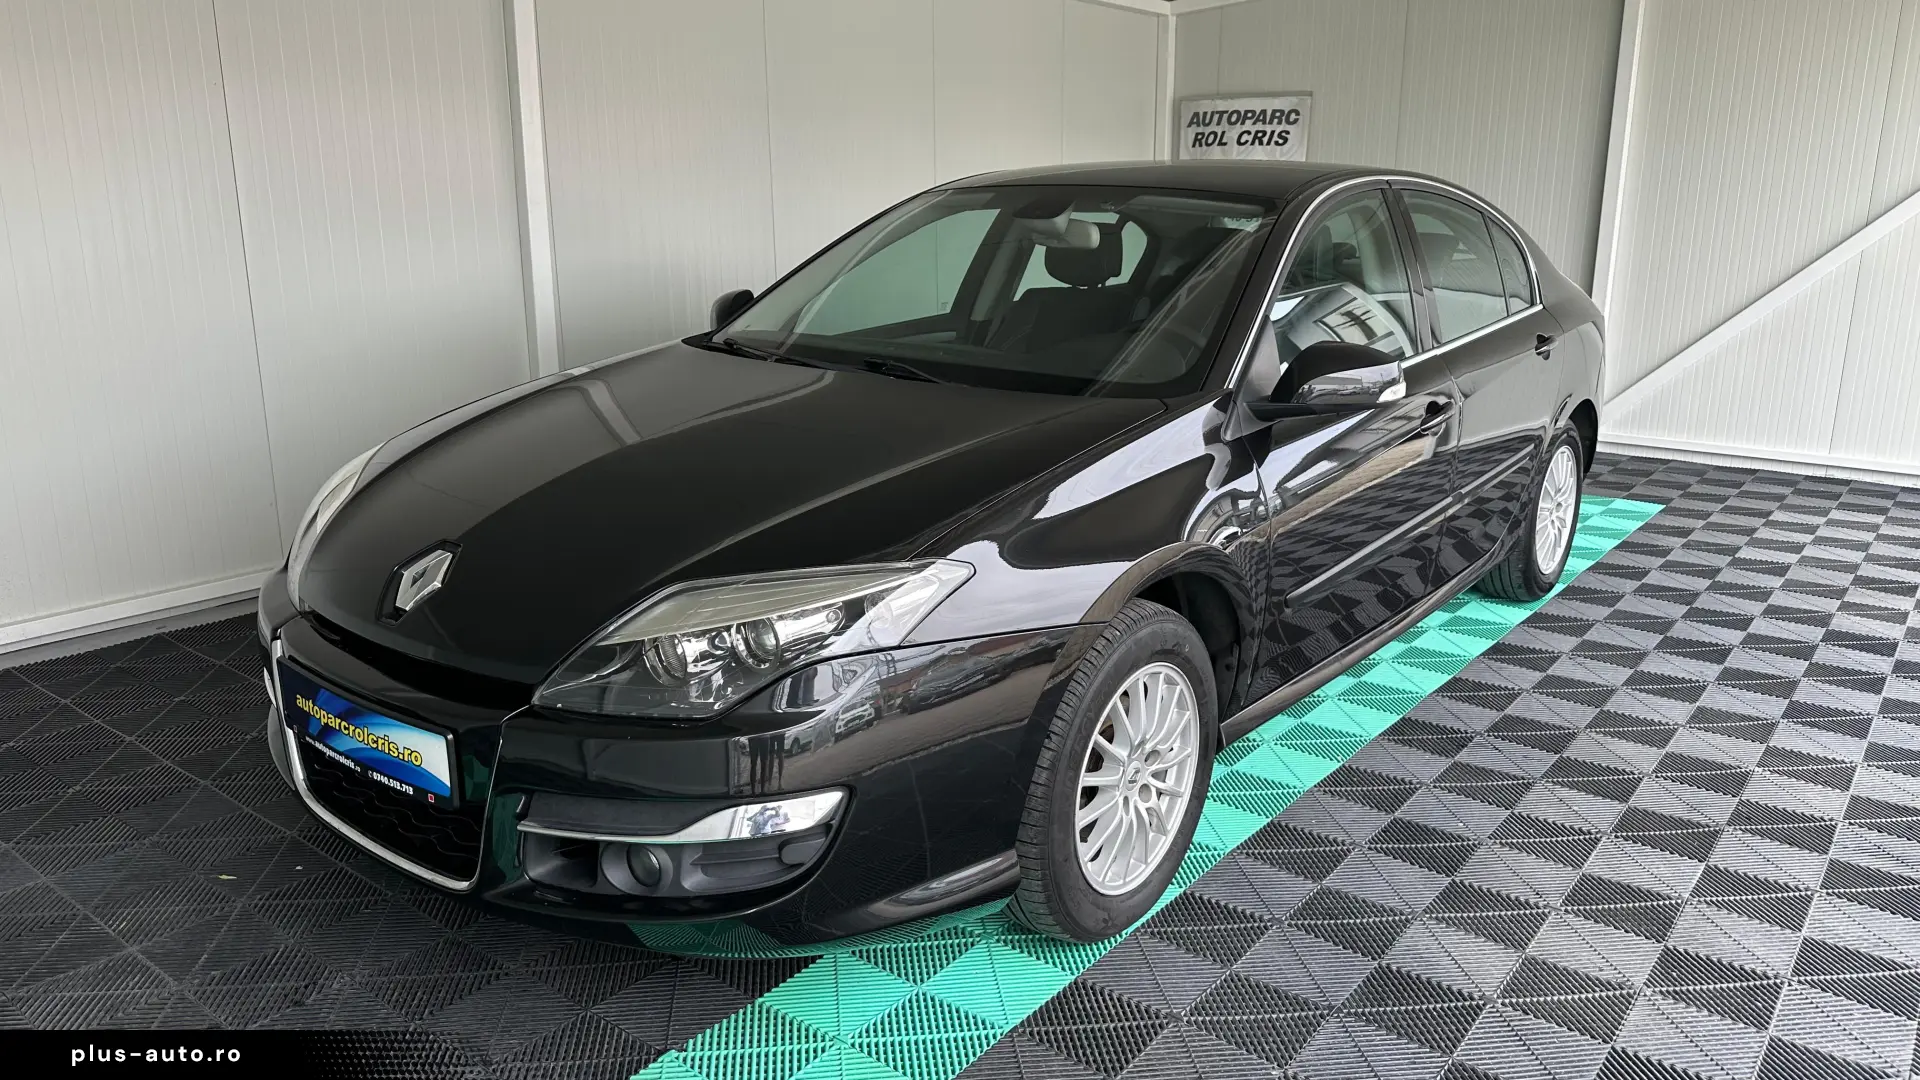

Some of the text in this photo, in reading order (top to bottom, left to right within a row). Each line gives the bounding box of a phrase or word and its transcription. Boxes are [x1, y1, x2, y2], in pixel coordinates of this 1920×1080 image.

[1187, 108, 1300, 128] AUTOPARC
[1191, 129, 1290, 148] ROL CRIS
[295, 693, 423, 768] autoparcrolcris.ro
[372, 771, 414, 795] 0740.513.713
